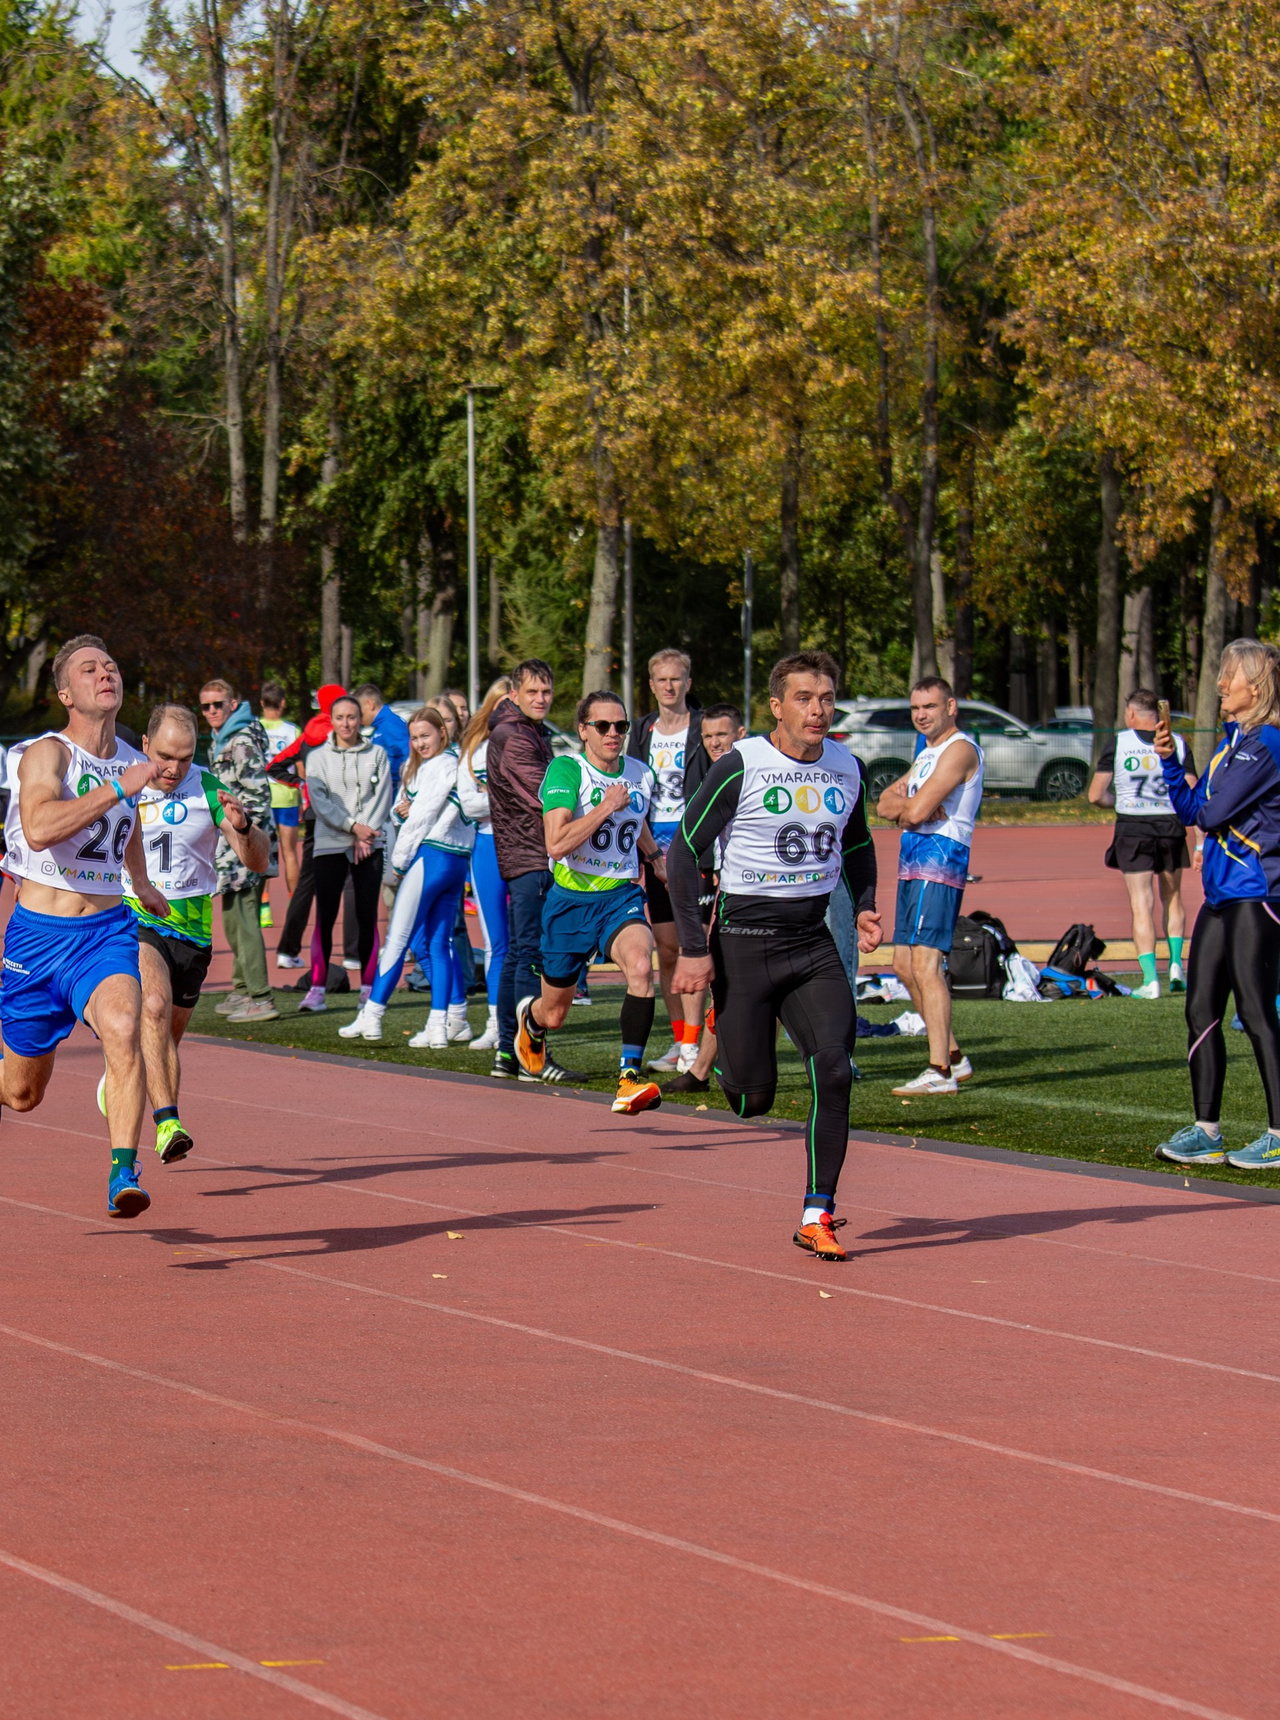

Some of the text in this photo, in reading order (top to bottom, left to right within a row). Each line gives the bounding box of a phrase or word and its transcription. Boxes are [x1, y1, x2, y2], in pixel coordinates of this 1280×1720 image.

[1123, 749, 1154, 757] VMARA
[78, 759, 130, 778] VMARAFO
[761, 772, 844, 786] VMARAFONE
[1129, 774, 1170, 798] 73
[75, 813, 133, 864] 26
[588, 817, 639, 857] 66
[719, 926, 779, 936] DEMIX
